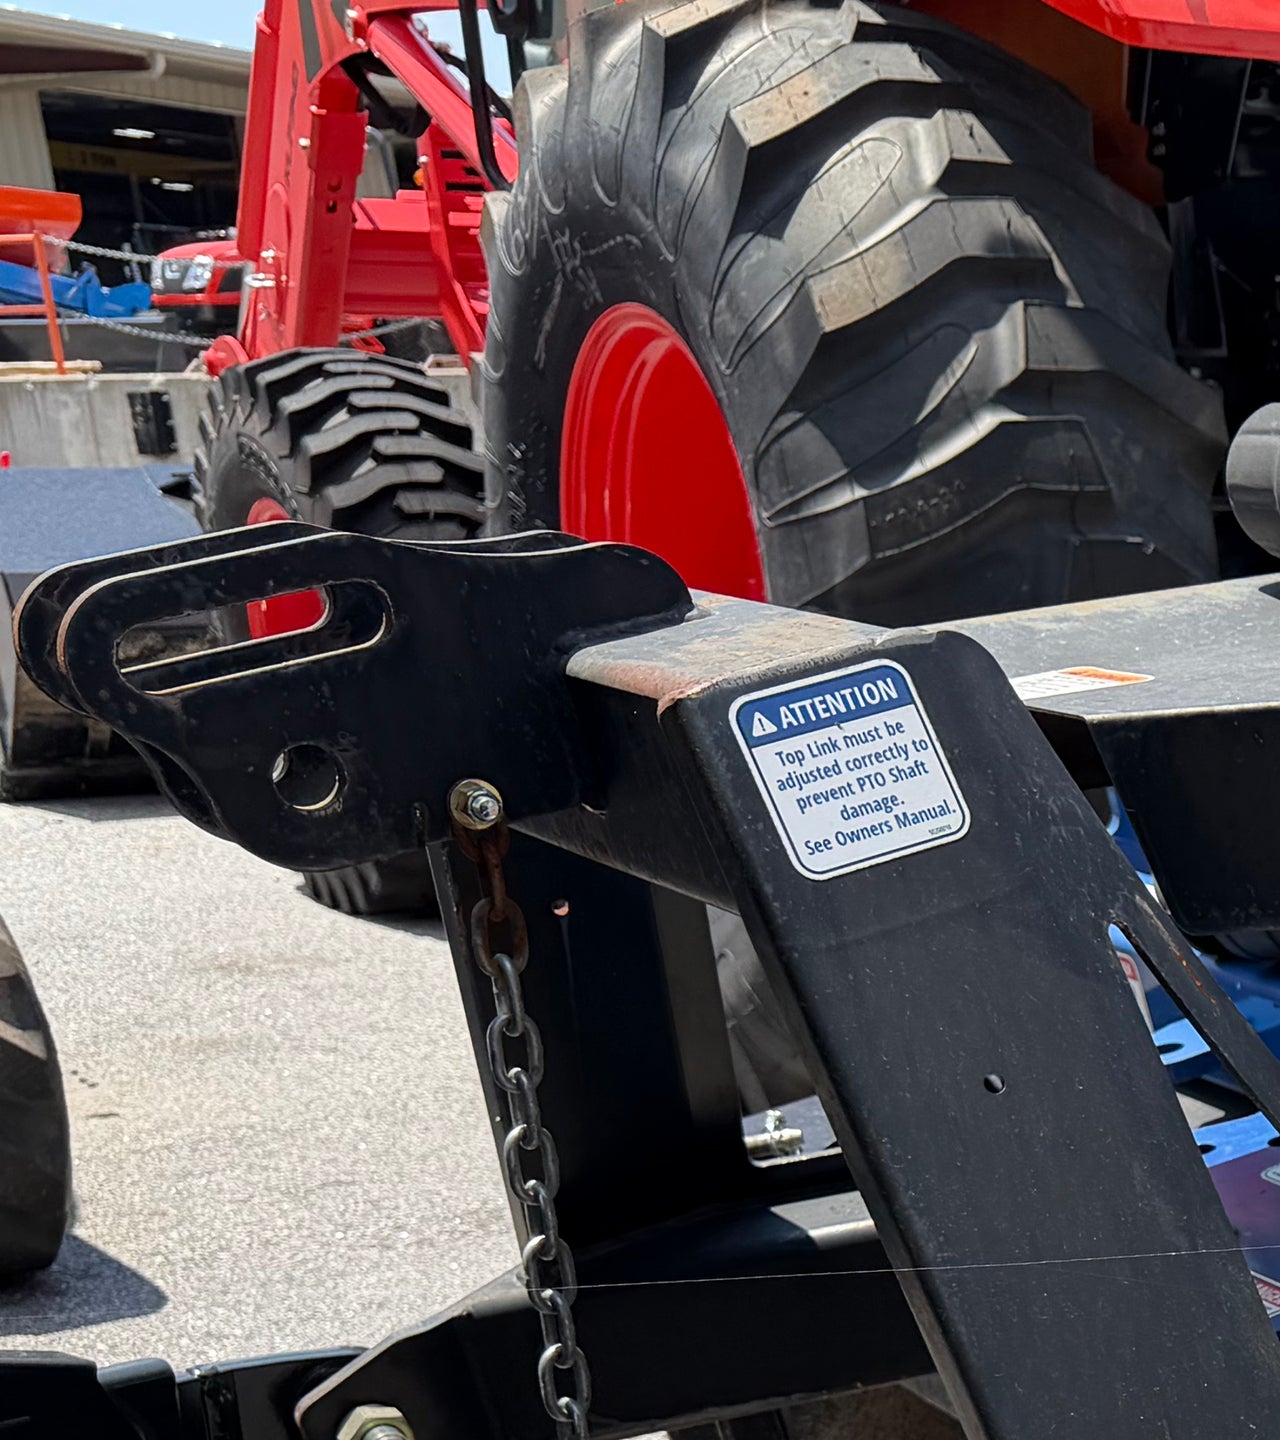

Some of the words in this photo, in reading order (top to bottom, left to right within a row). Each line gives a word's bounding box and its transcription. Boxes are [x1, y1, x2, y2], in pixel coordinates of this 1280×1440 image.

[779, 678, 899, 730] ATTENTION
[775, 750, 806, 768] Top
[809, 736, 842, 759] Link
[843, 727, 883, 750] must
[887, 720, 906, 738] be
[776, 763, 842, 793] adjusted
[845, 741, 909, 772] correctly
[911, 738, 929, 753] to
[796, 781, 855, 814] prevent
[859, 771, 887, 794] PTO
[891, 760, 929, 784] Shaft
[840, 794, 905, 821] damage.
[804, 837, 833, 856] See
[835, 819, 893, 846] Owners
[896, 799, 957, 831] Manual.
